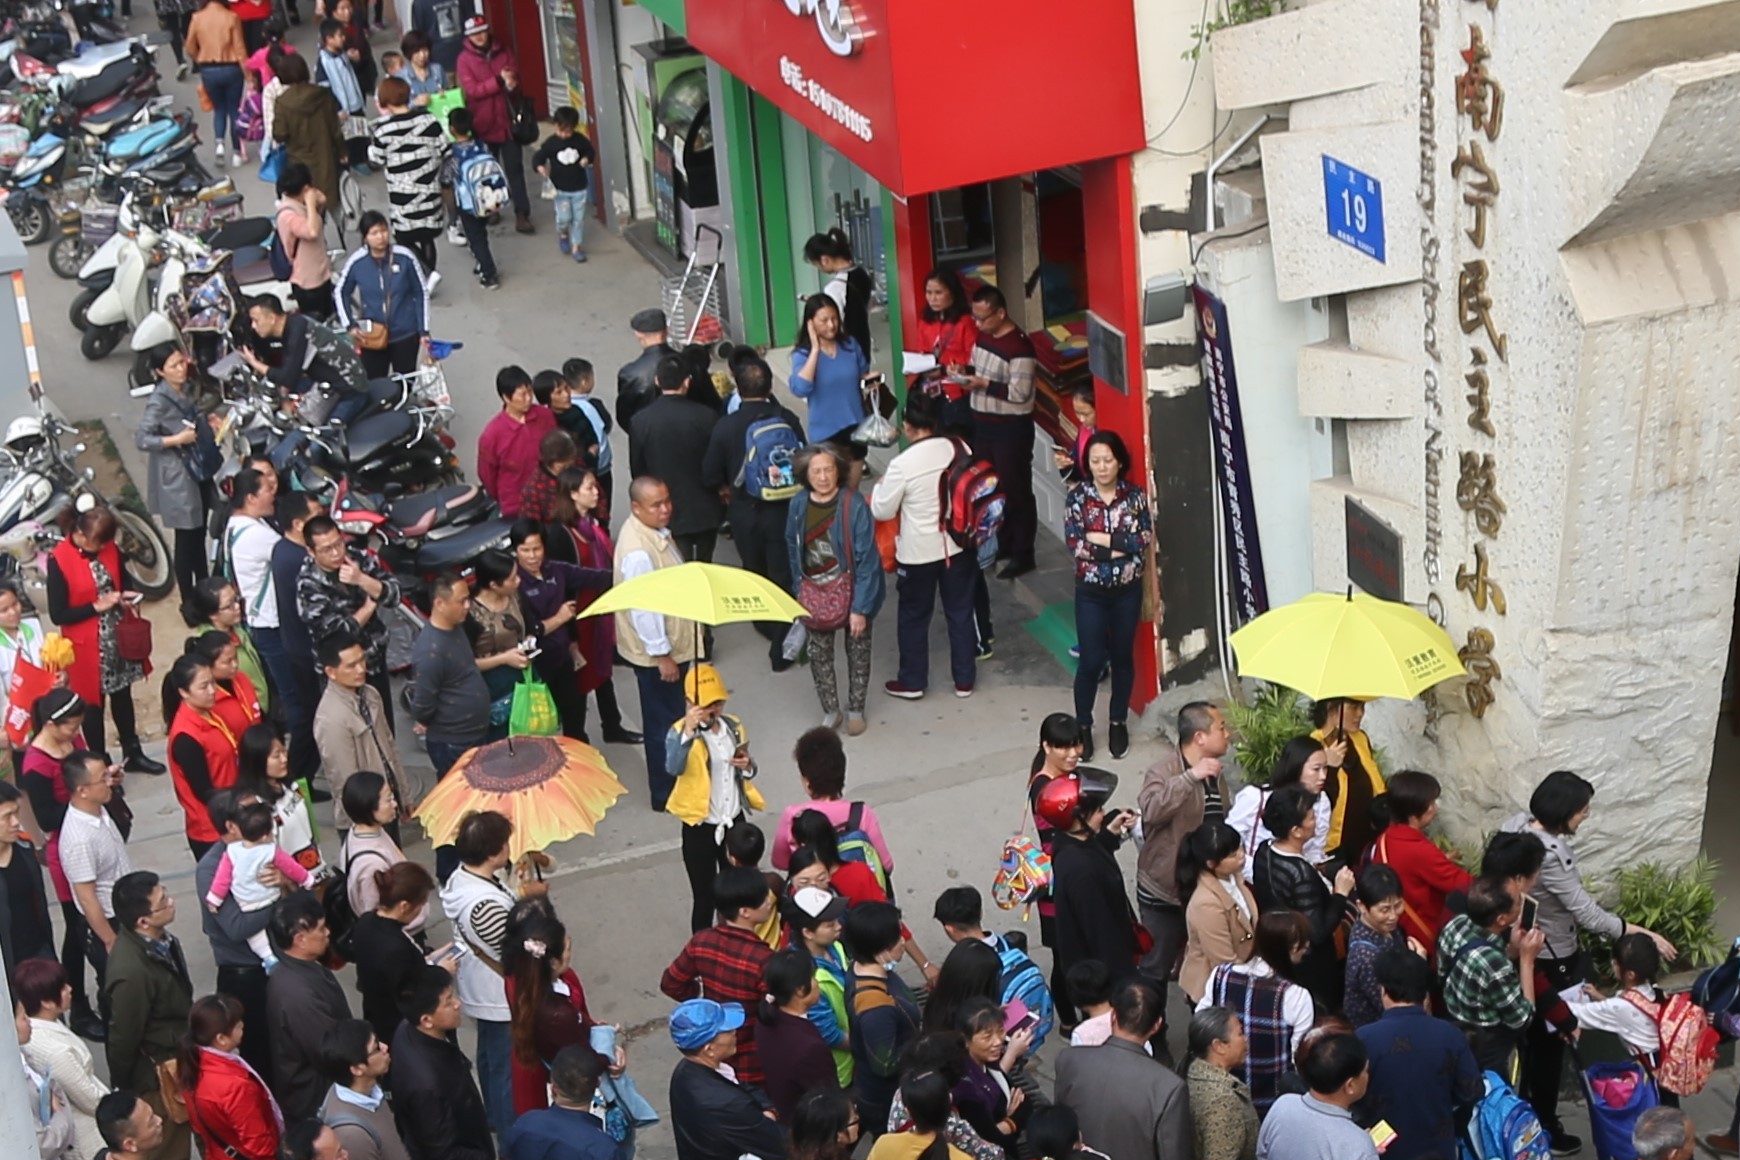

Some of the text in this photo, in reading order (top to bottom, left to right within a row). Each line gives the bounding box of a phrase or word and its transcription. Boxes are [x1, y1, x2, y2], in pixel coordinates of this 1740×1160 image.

[1341, 188, 1367, 234] 19
[1420, 226, 1441, 363] School
[1451, 0, 1508, 719] 南宁民主路小学
[1424, 368, 1443, 417] of
[1424, 418, 1443, 586] Nanning
